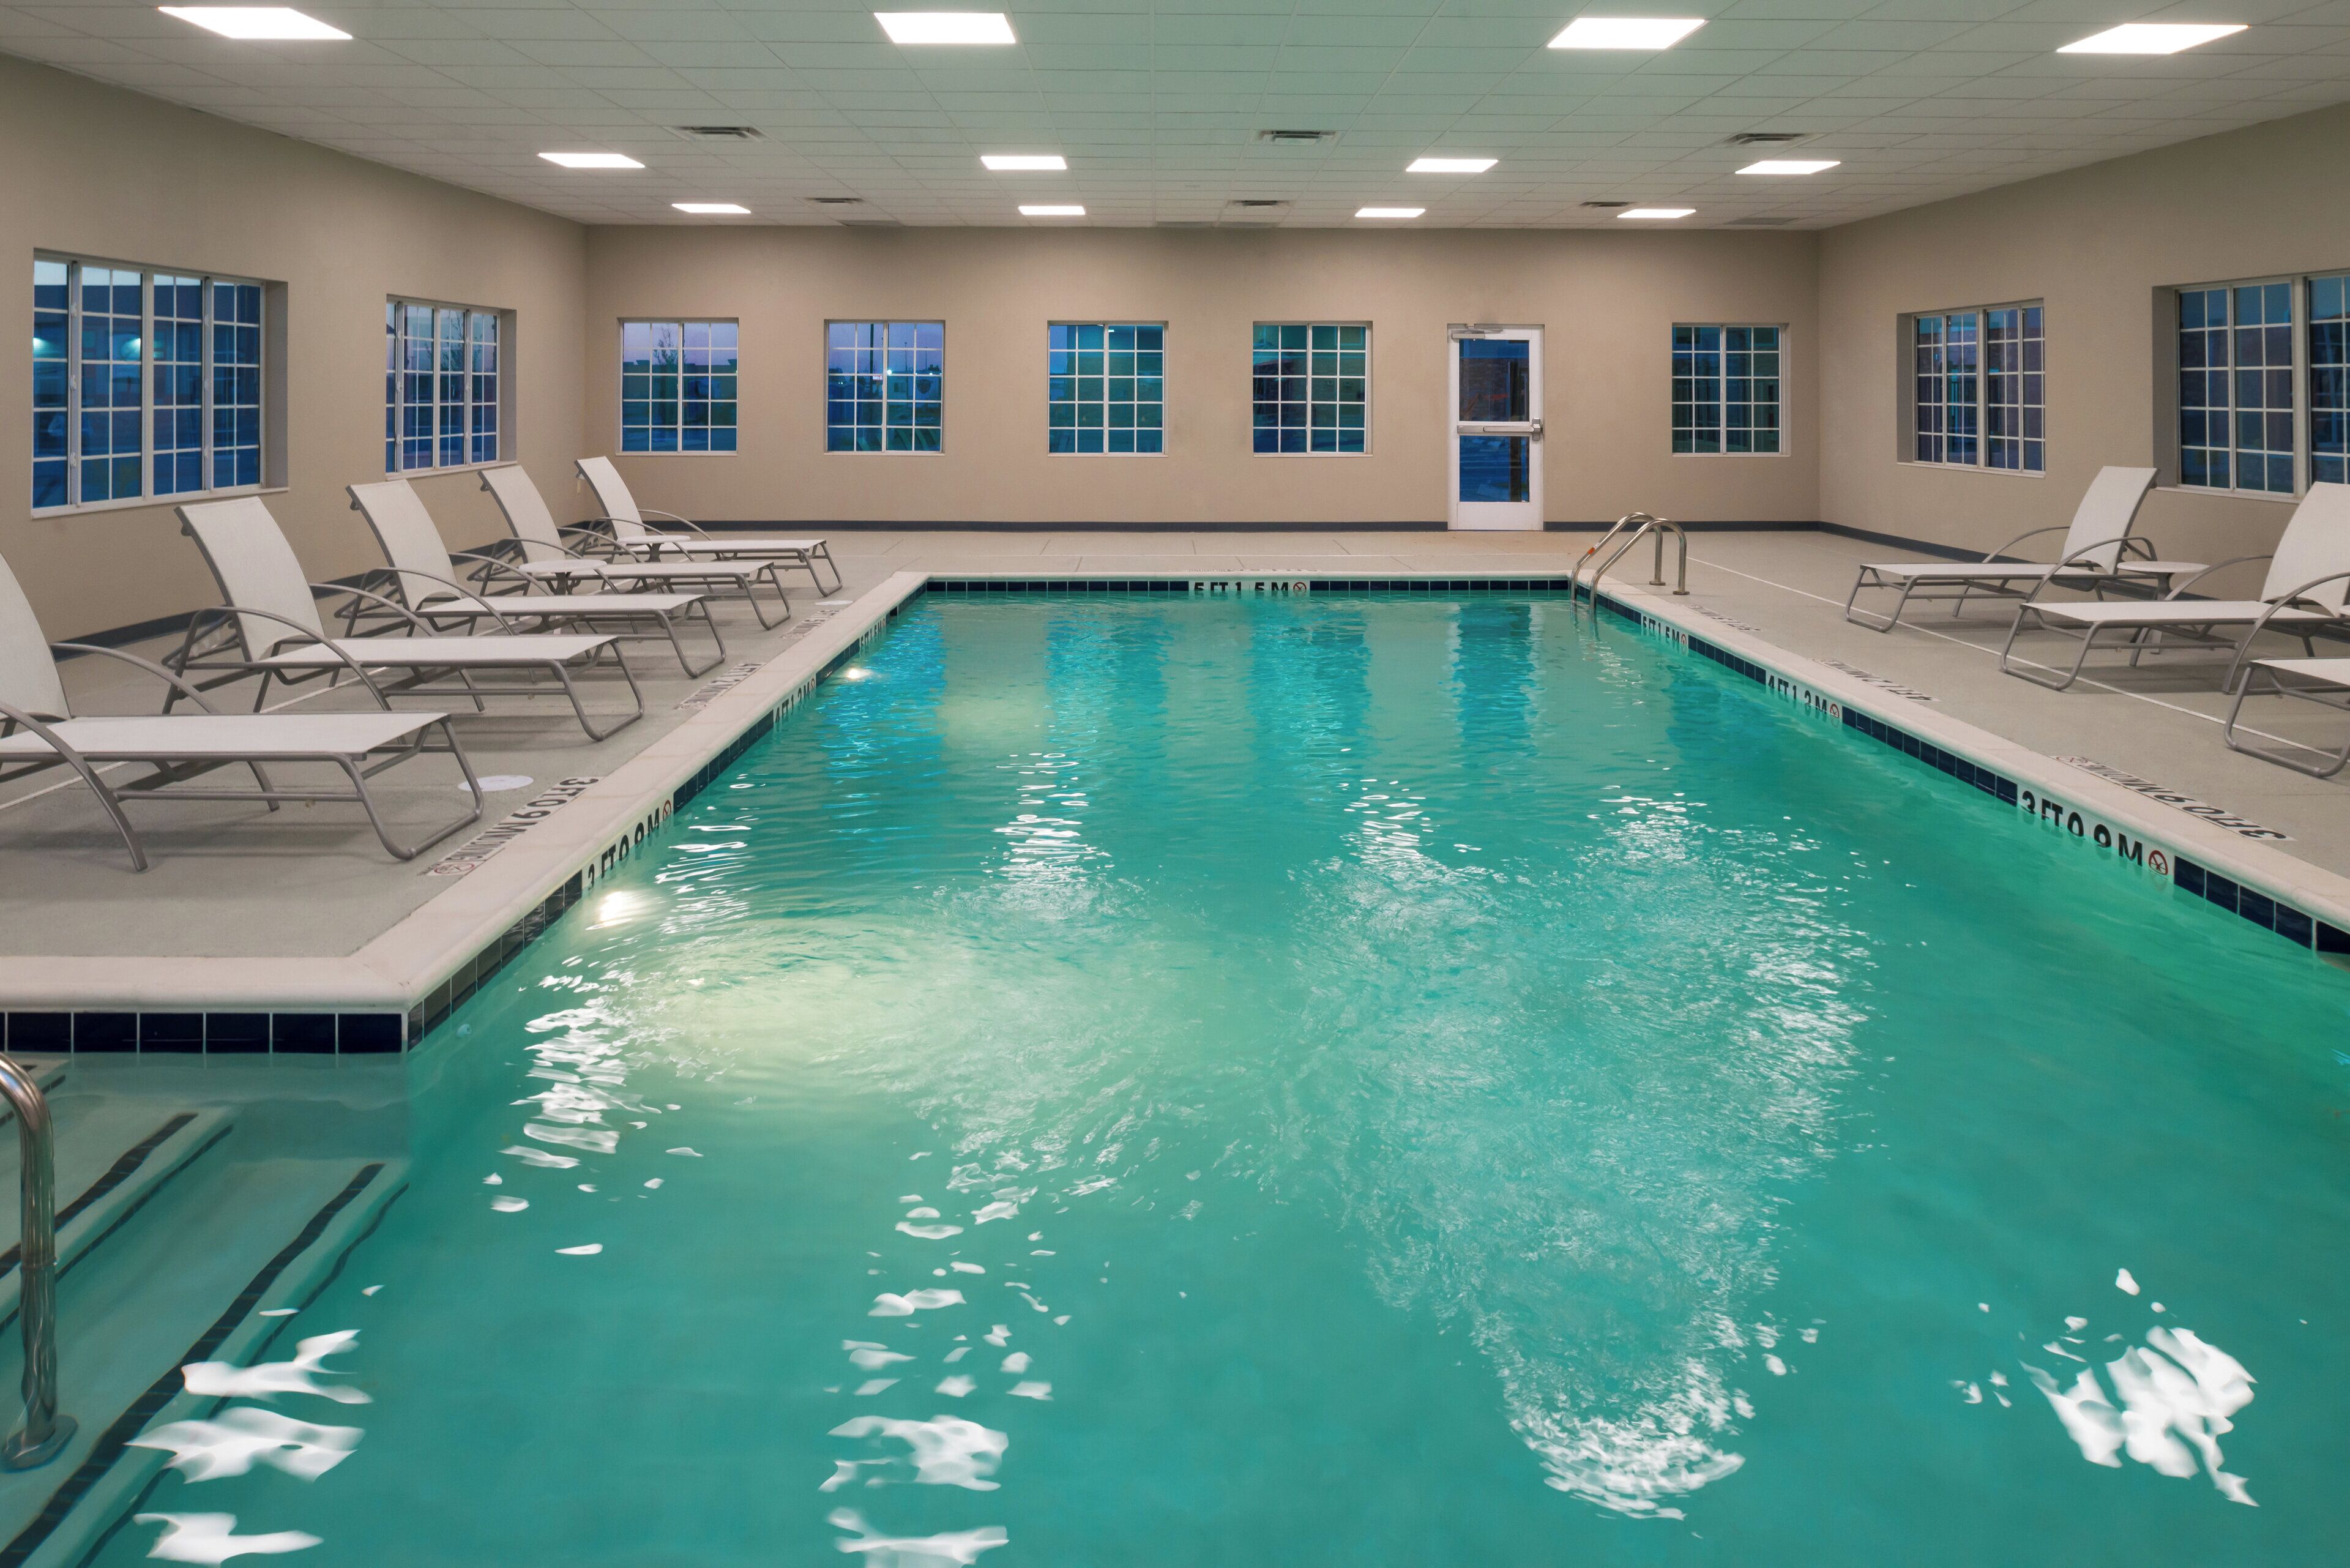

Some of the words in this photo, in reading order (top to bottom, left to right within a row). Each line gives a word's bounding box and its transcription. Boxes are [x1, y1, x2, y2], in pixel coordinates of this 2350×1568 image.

[647, 807, 659, 838] M
[2041, 797, 2064, 827] FT
[2119, 832, 2143, 867] M
